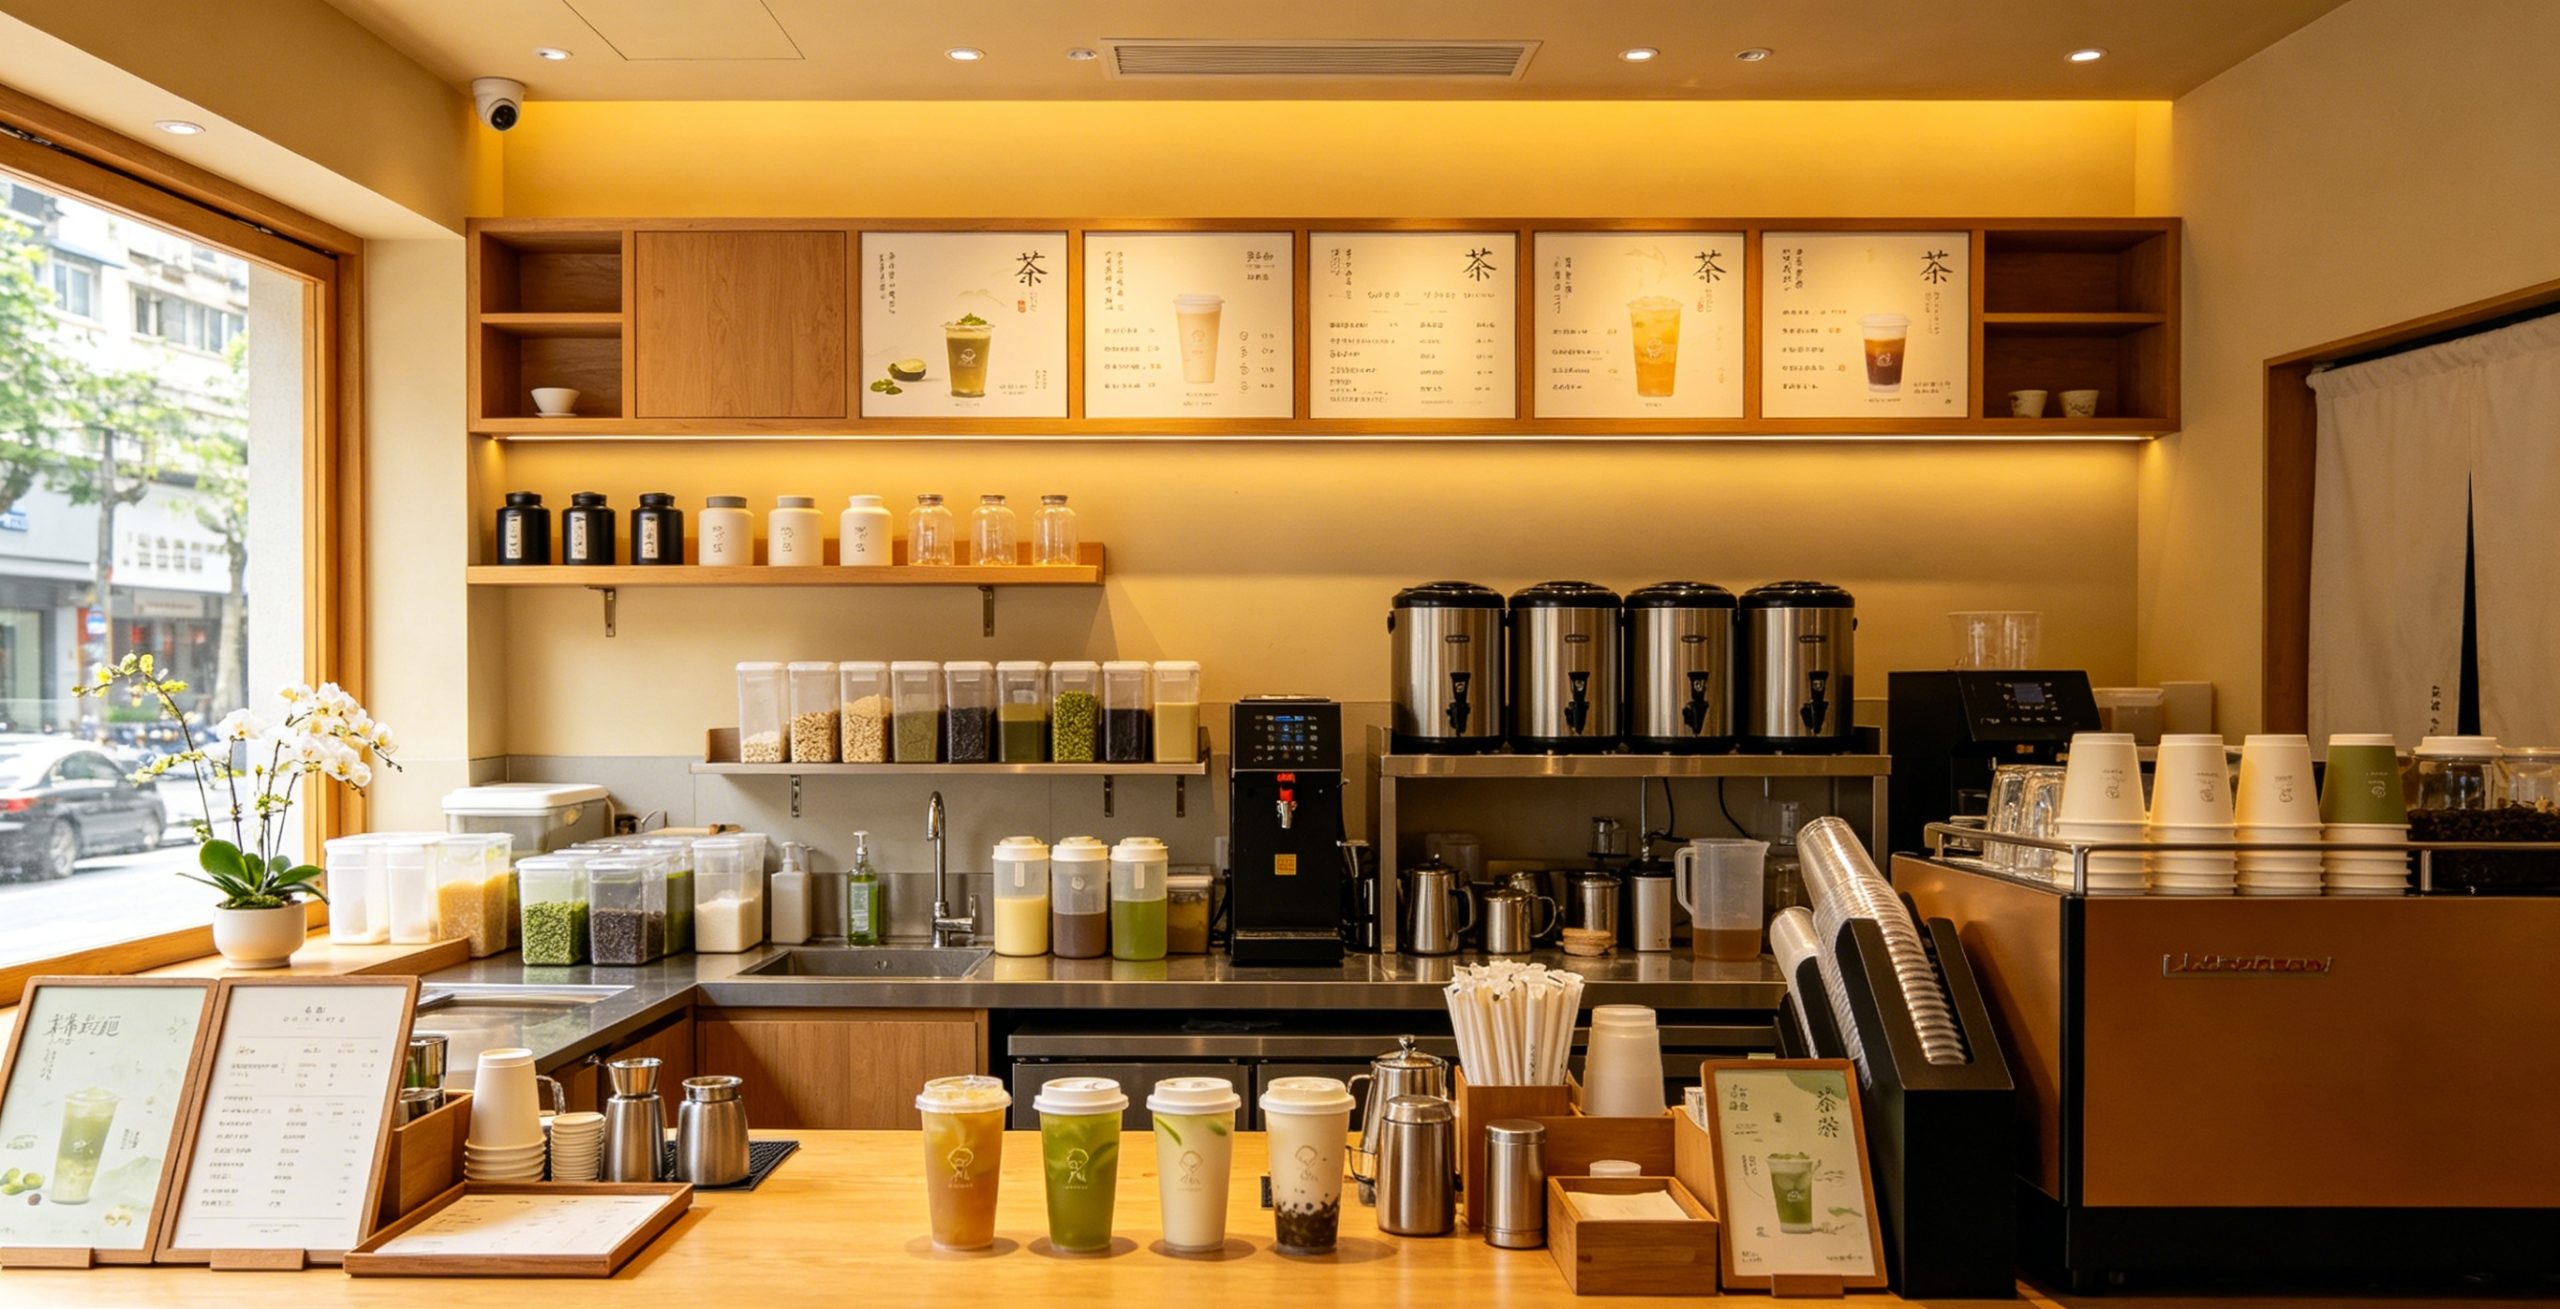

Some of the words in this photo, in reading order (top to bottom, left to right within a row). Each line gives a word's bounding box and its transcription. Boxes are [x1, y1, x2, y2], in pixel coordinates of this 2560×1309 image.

[1014, 250, 1048, 287] 茶
[1463, 247, 1497, 282] 茶
[1693, 249, 1727, 284] 茶
[1919, 249, 1953, 285] 茶
